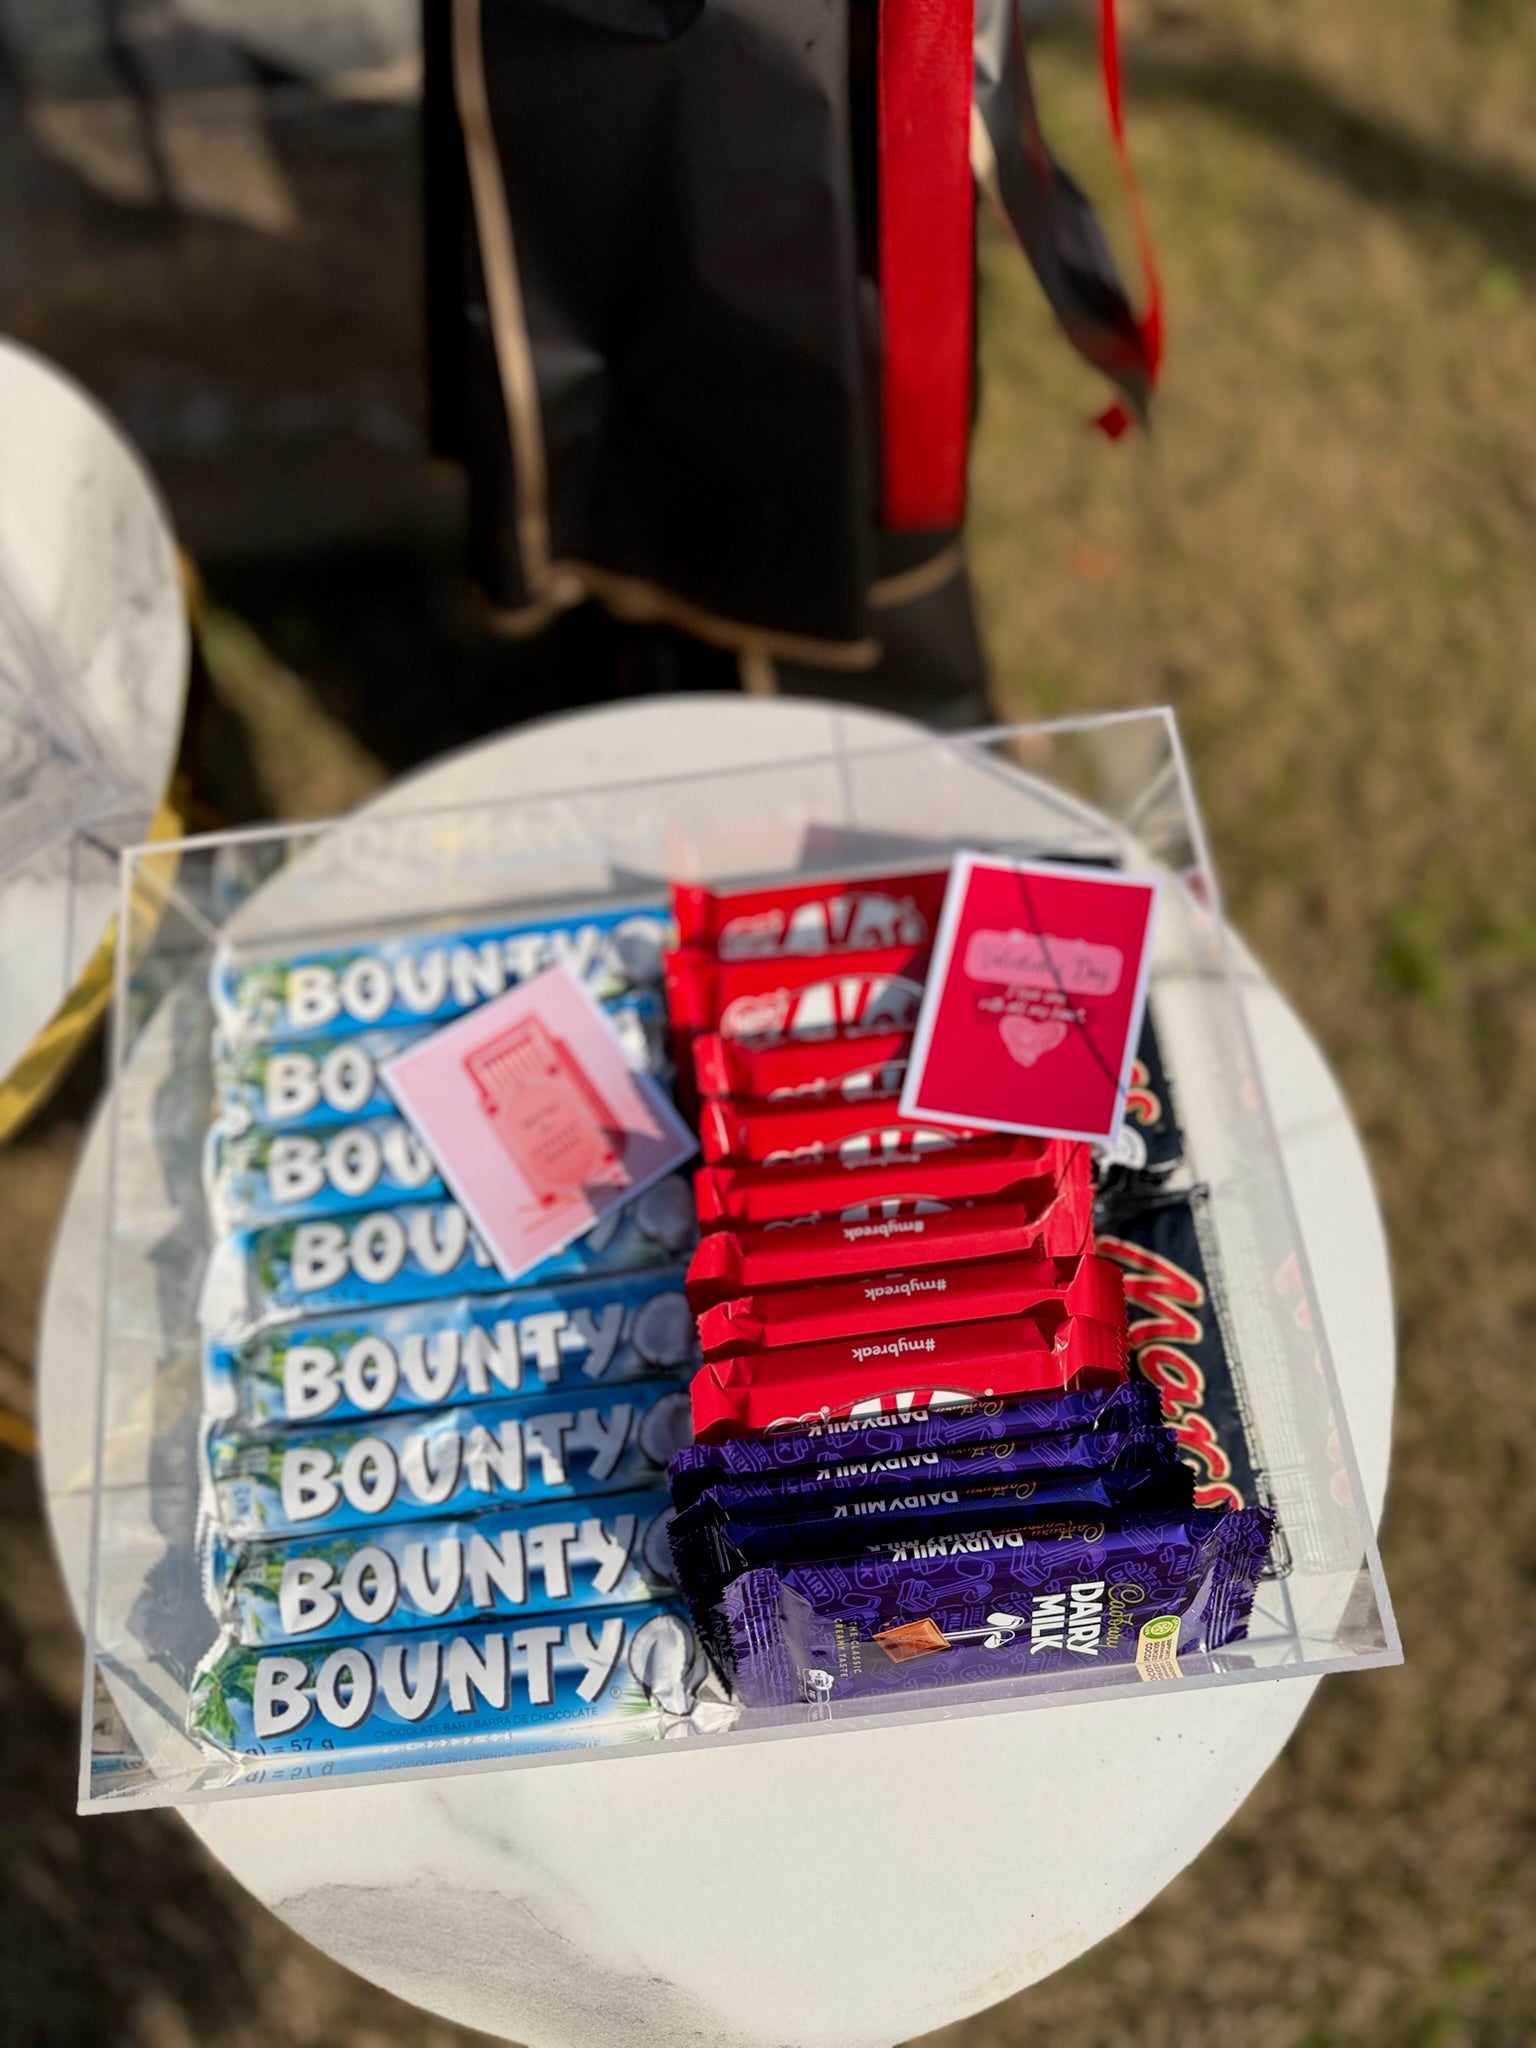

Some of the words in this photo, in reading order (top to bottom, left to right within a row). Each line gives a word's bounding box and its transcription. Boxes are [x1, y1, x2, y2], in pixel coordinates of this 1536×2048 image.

[286, 923, 602, 1030] BOUNTY
[267, 1122, 436, 1203] BOU
[843, 1218, 925, 1242] #mybreak
[864, 1278, 947, 1301] #mybreak
[283, 1303, 626, 1420] BOUNTY
[851, 1337, 936, 1362] #mybreak
[280, 1402, 634, 1523] BOUNTY
[278, 1513, 638, 1636] BOUNTY
[834, 1618, 847, 1650] CREAMY
[849, 1620, 858, 1637] THE
[1030, 1593, 1066, 1655] MILK
[1066, 1581, 1105, 1656] DAIRY
[1104, 1582, 1145, 1649] Cadbury
[253, 1616, 628, 1741] BOUNTY
[838, 1653, 849, 1678] TASTE
[850, 1640, 862, 1674] CLASSIC
[290, 1736, 314, 1752] 57
[374, 1722, 442, 1740] CHOCOLATE
[443, 1720, 467, 1732] BAR
[474, 1715, 512, 1729] BARRA
[514, 1713, 529, 1725] DE
[532, 1706, 599, 1723] CHOCOLATE
